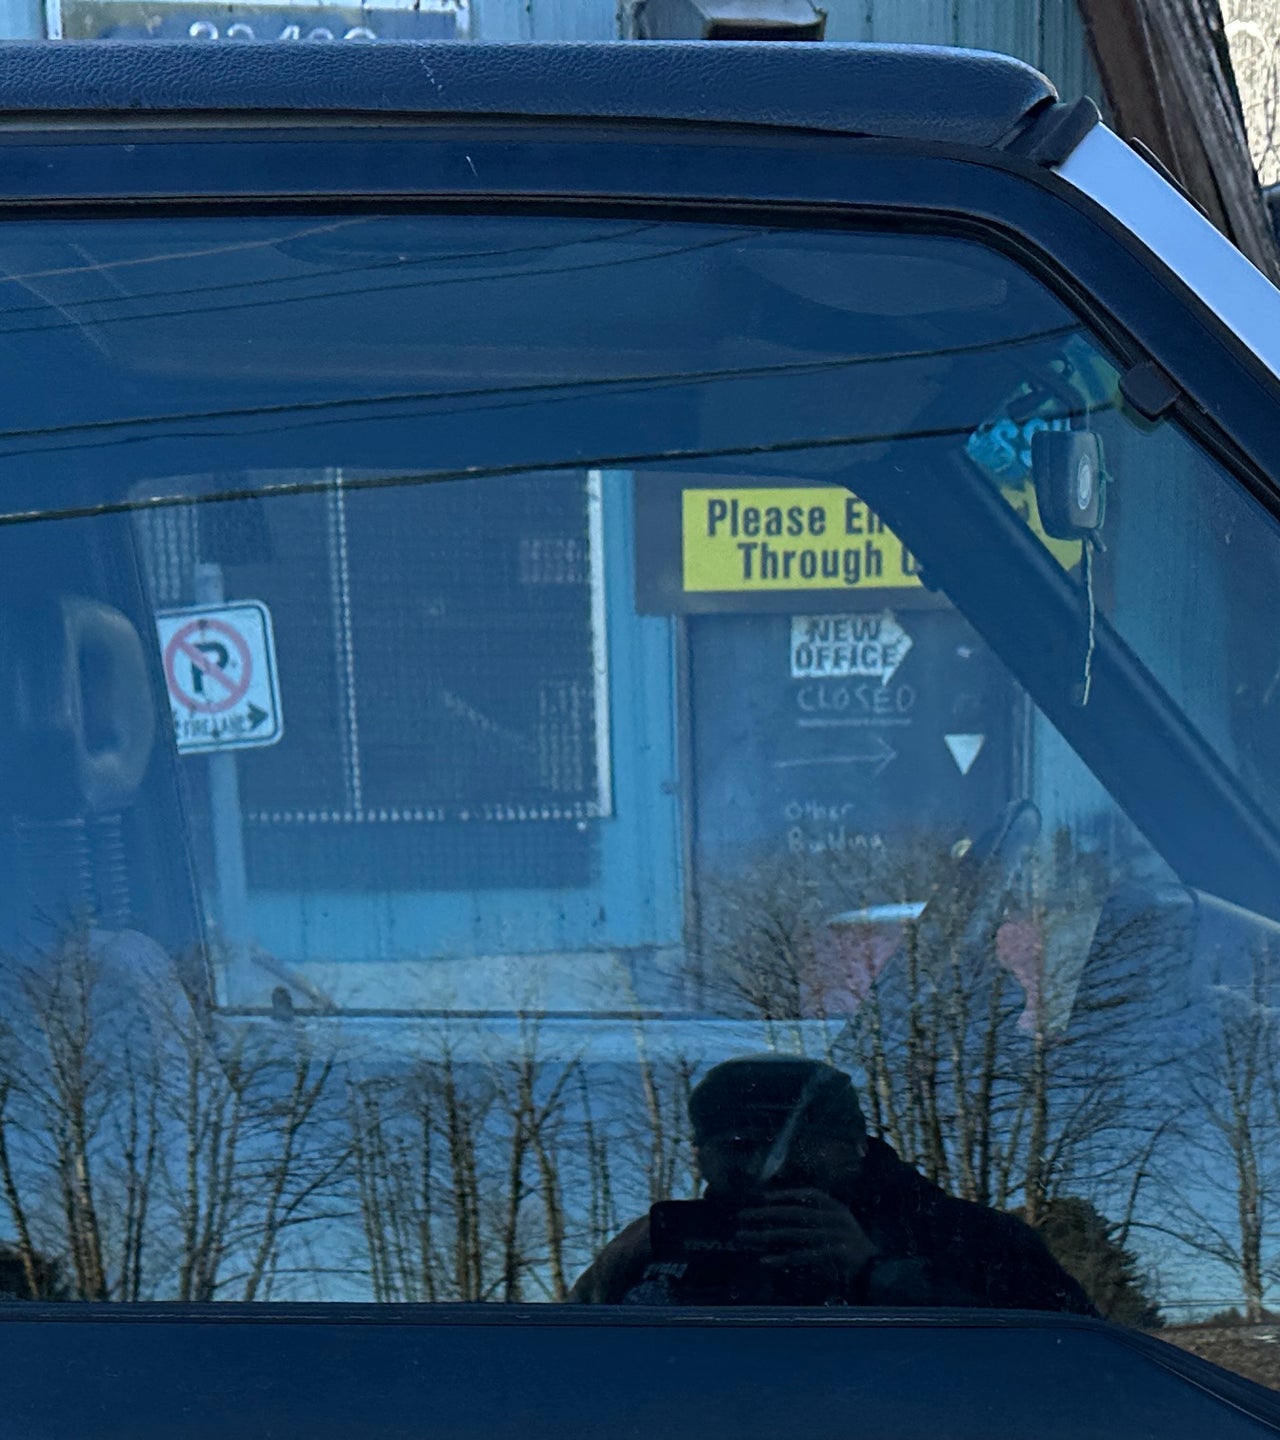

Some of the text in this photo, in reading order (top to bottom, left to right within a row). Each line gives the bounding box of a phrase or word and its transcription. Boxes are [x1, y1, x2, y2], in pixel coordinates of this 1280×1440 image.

[707, 498, 826, 537] Please
[737, 539, 883, 584] Through
[806, 617, 881, 643] NEW
[795, 642, 899, 671] OFFICE
[797, 684, 917, 714] CLOSED
